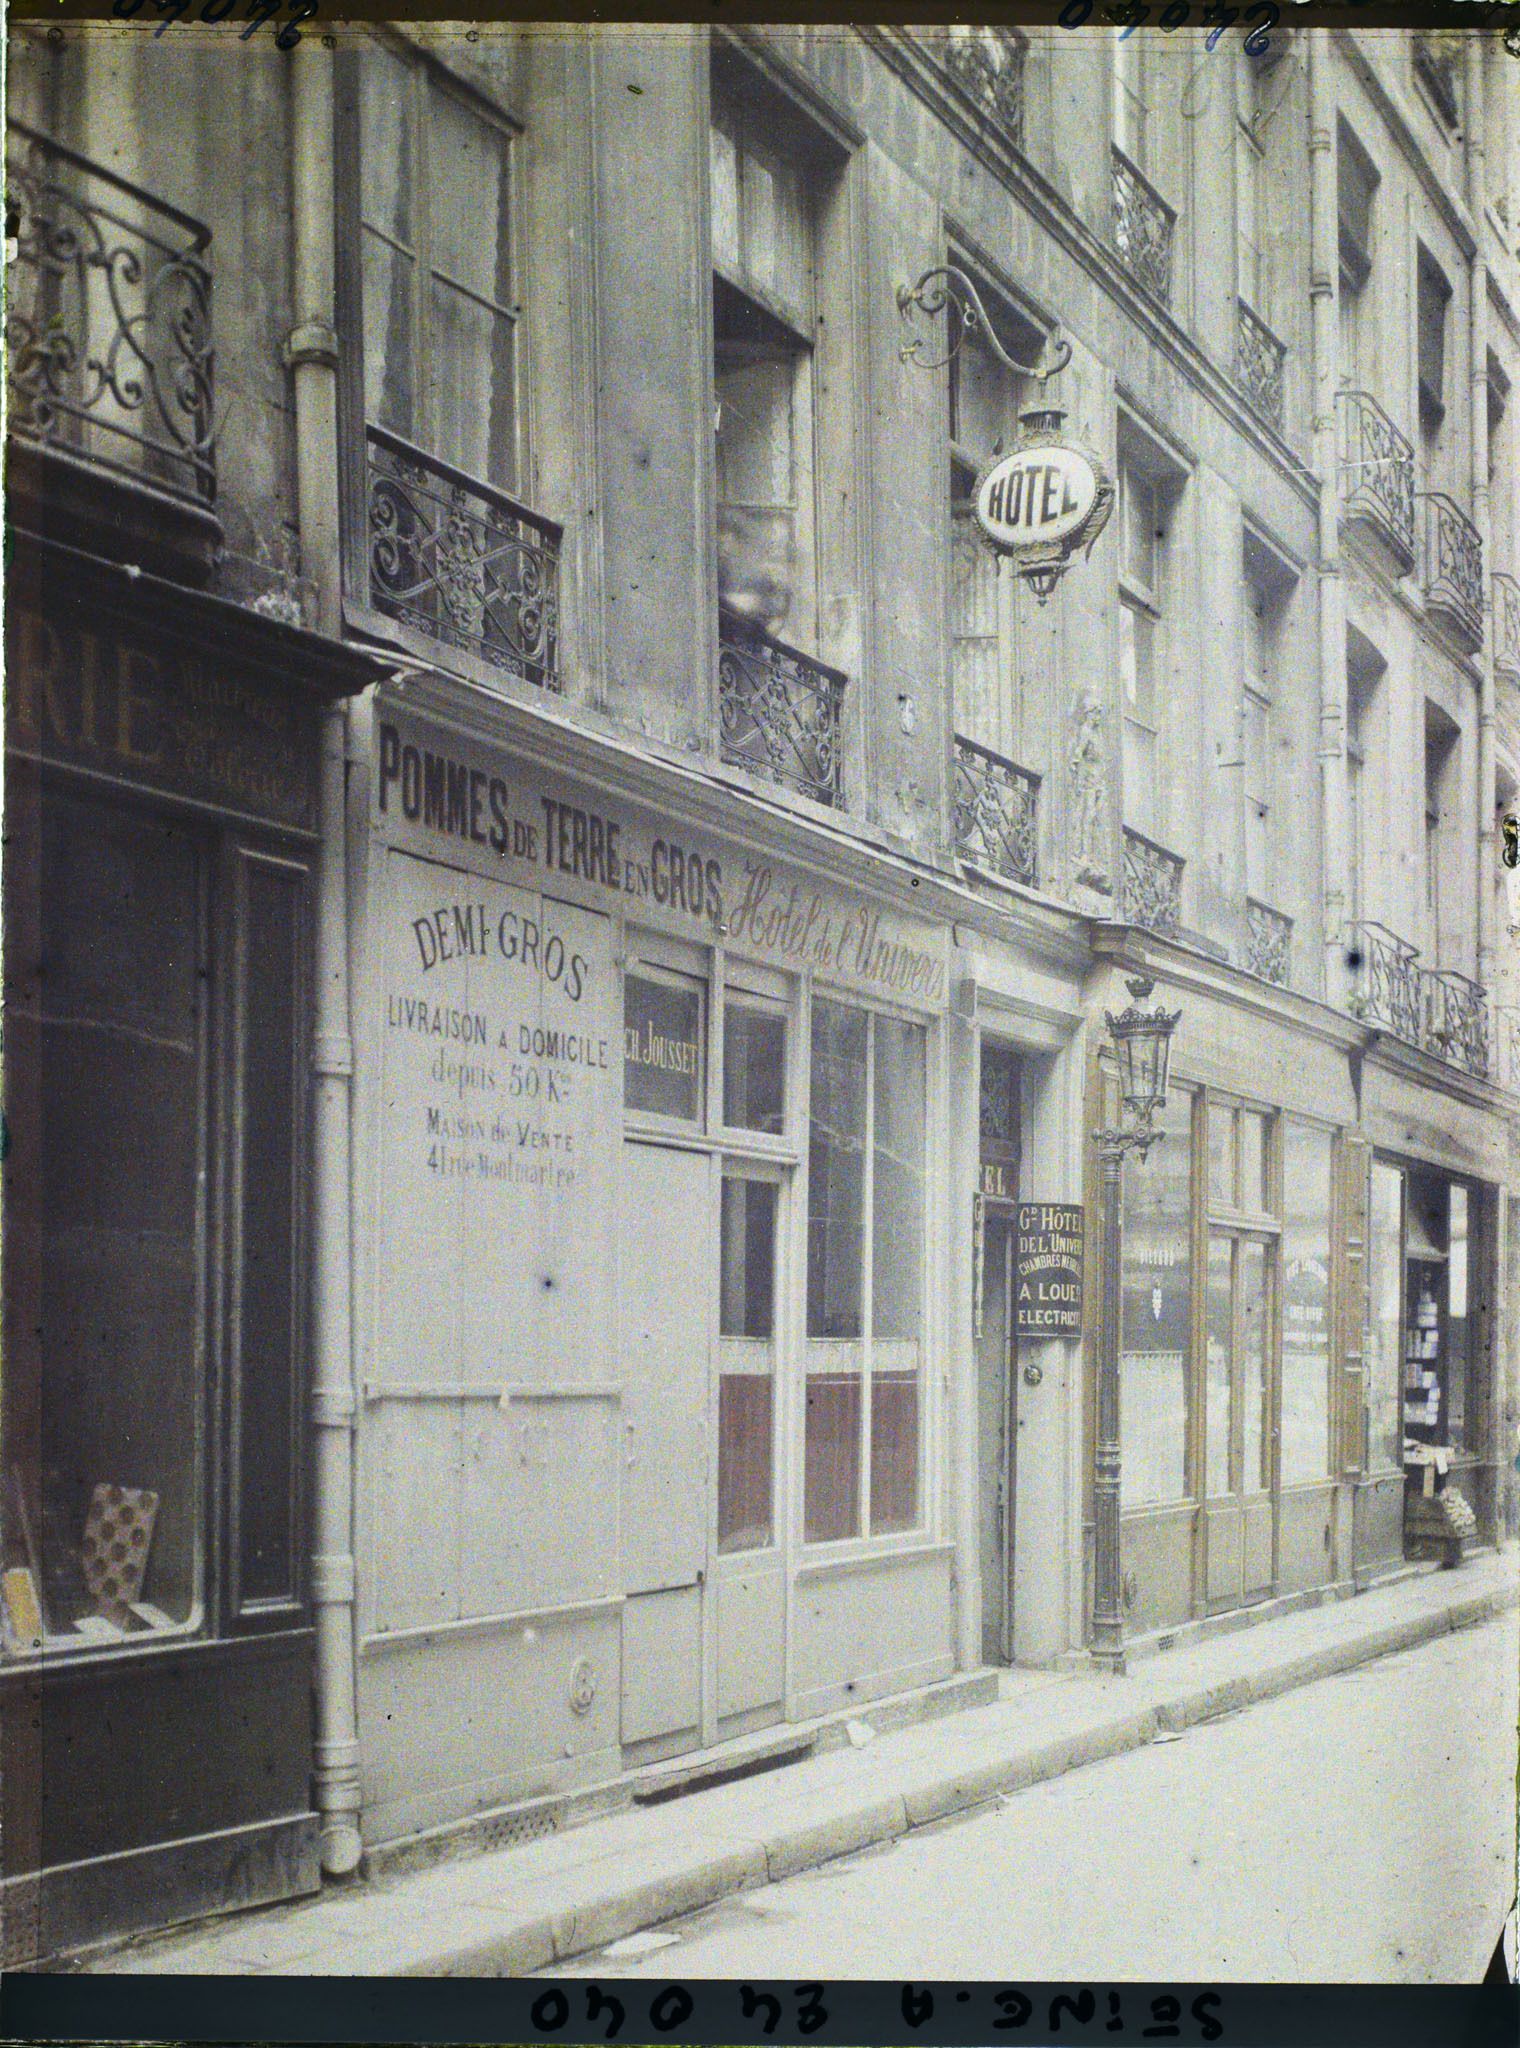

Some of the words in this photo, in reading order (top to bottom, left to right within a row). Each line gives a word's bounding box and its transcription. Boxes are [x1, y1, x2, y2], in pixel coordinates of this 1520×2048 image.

[988, 461, 1078, 527] HÔTEL
[379, 724, 508, 855] POMMES
[513, 819, 538, 862] DE
[541, 795, 621, 889] TERRE
[625, 859, 649, 897] EN
[651, 838, 722, 930] GROS
[388, 995, 487, 1045] LIVRAISON
[500, 1031, 508, 1050] A
[519, 1024, 608, 1070] DOMICILE
[517, 1123, 576, 1153] VENTE
[1018, 1254, 1061, 1276] CHAMBRES
[1019, 1282, 1032, 1300] A
